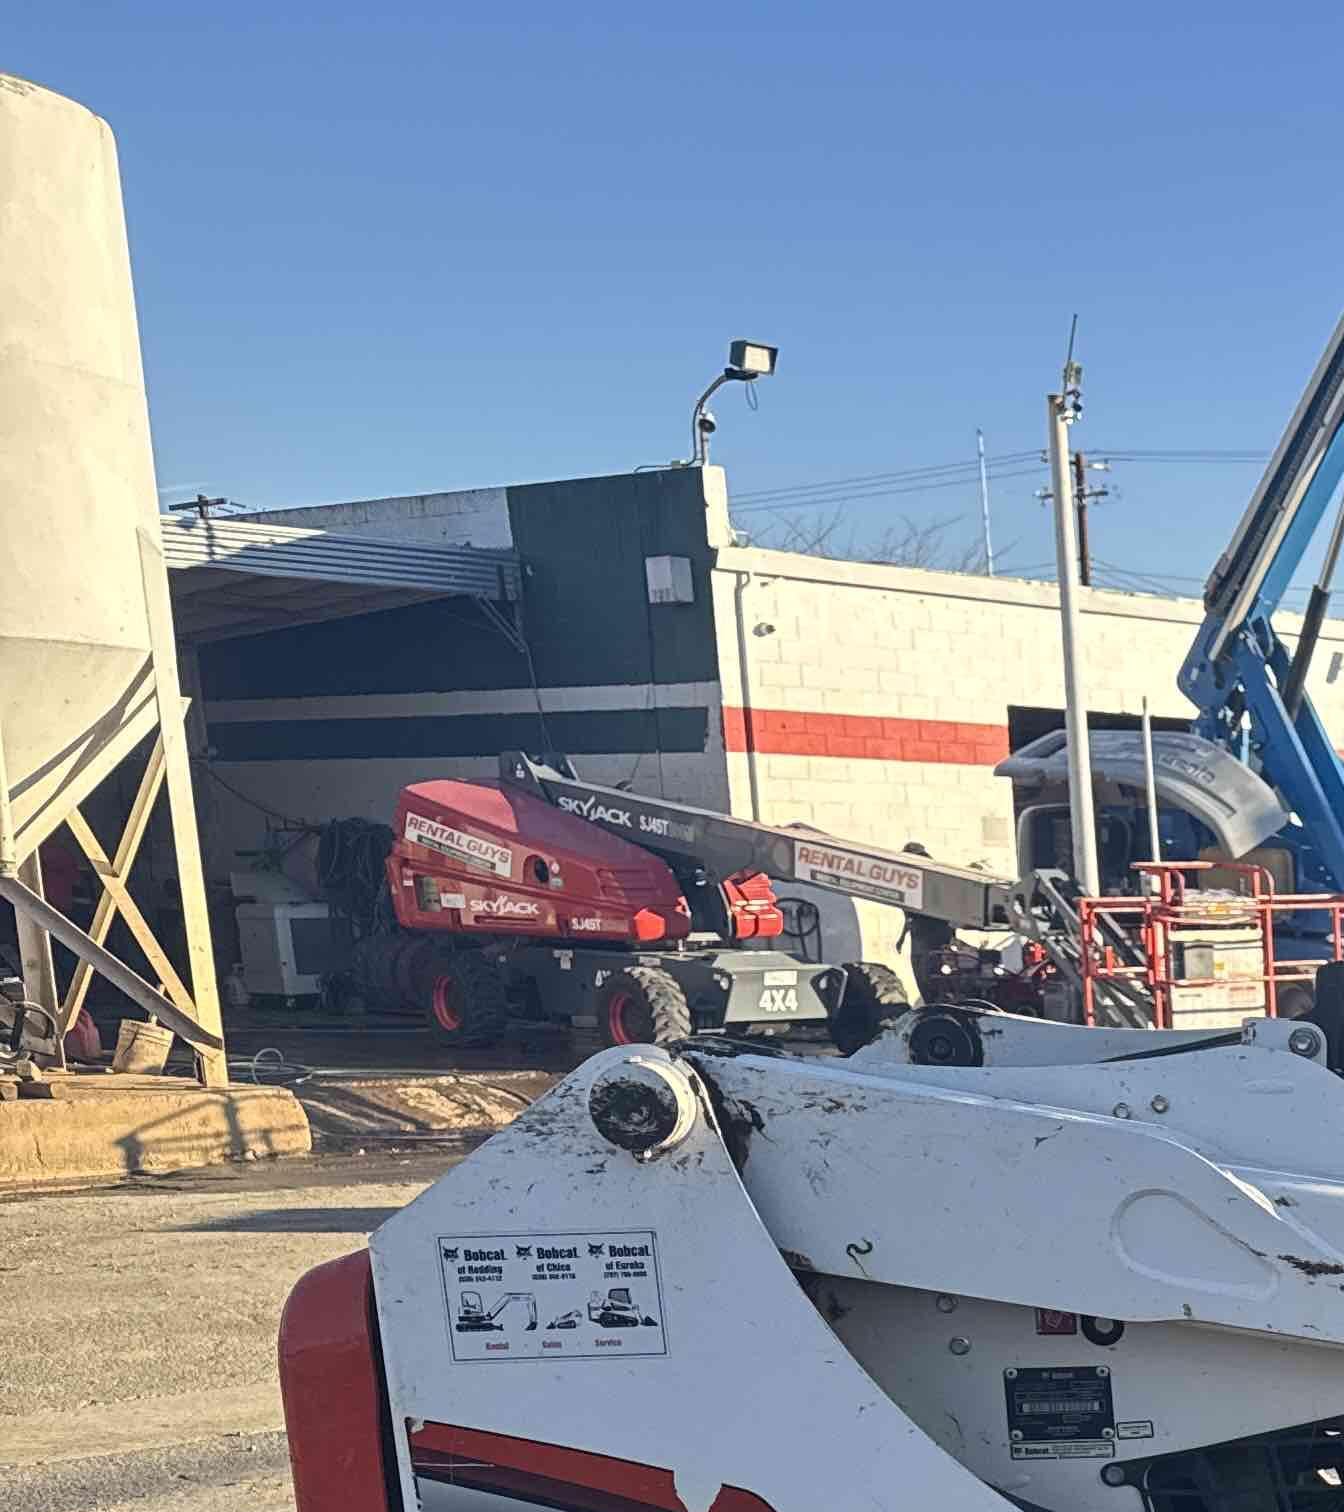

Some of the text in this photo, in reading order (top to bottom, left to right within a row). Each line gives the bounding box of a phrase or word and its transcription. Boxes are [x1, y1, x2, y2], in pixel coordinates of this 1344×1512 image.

[558, 796, 632, 828] SKYJACK
[407, 816, 465, 848] RENTAL
[466, 839, 510, 863] GUYS
[799, 847, 866, 877] RENTAL
[869, 864, 919, 889] GUYS
[470, 896, 540, 915] SKYJACK
[759, 989, 798, 1012] 4X4
[463, 1249, 505, 1261] Bobcat
[536, 1247, 577, 1259] Bobcat
[609, 1245, 649, 1257] Bobcat
